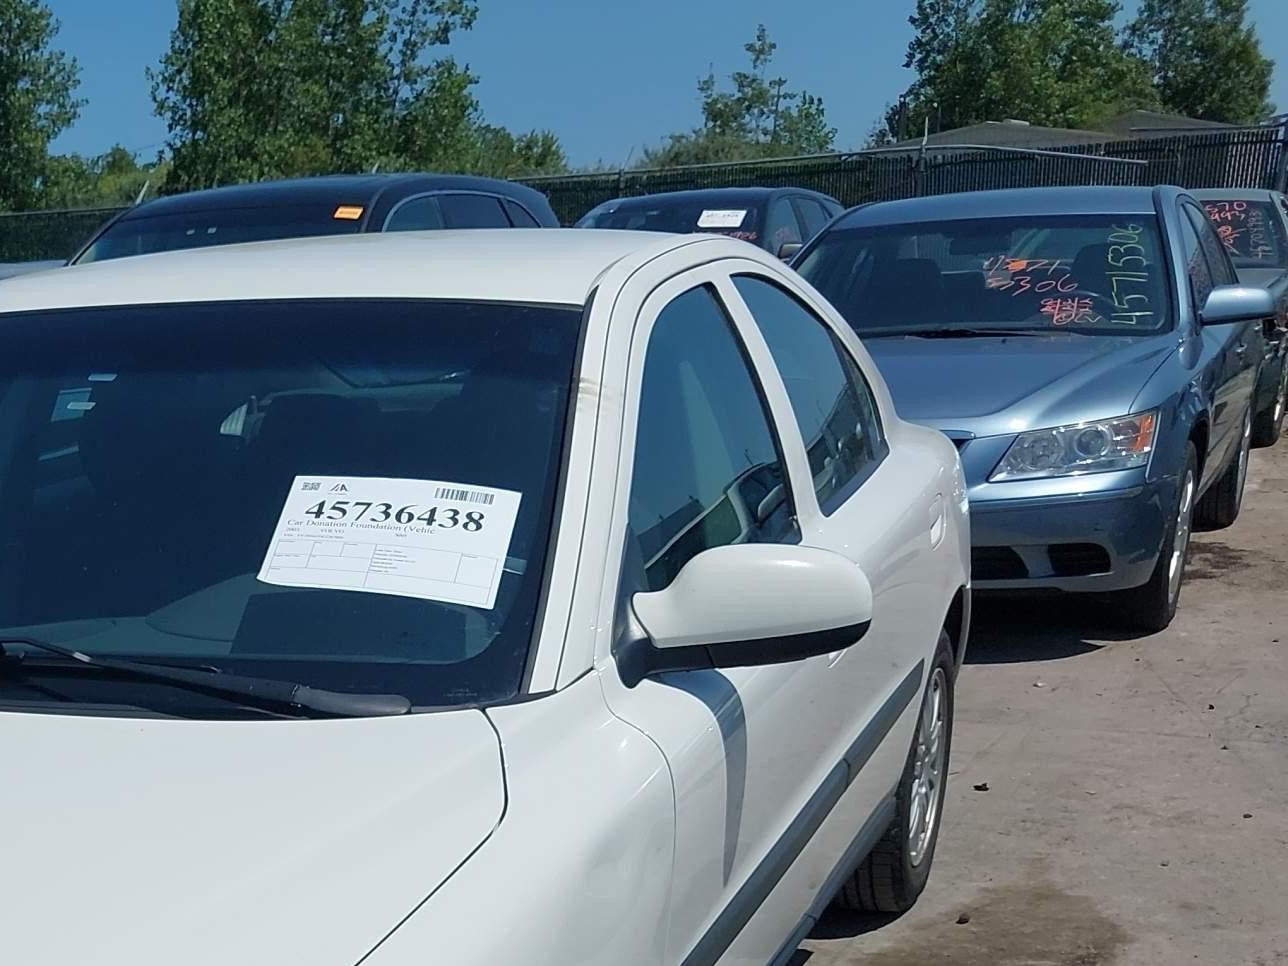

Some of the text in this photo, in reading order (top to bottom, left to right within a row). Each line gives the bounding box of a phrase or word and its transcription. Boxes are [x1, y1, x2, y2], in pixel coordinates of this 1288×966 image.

[1106, 223, 1154, 325] 45715306
[304, 499, 485, 533] 45736438
[306, 520, 348, 528] Donation
[350, 521, 402, 532] Foundation
